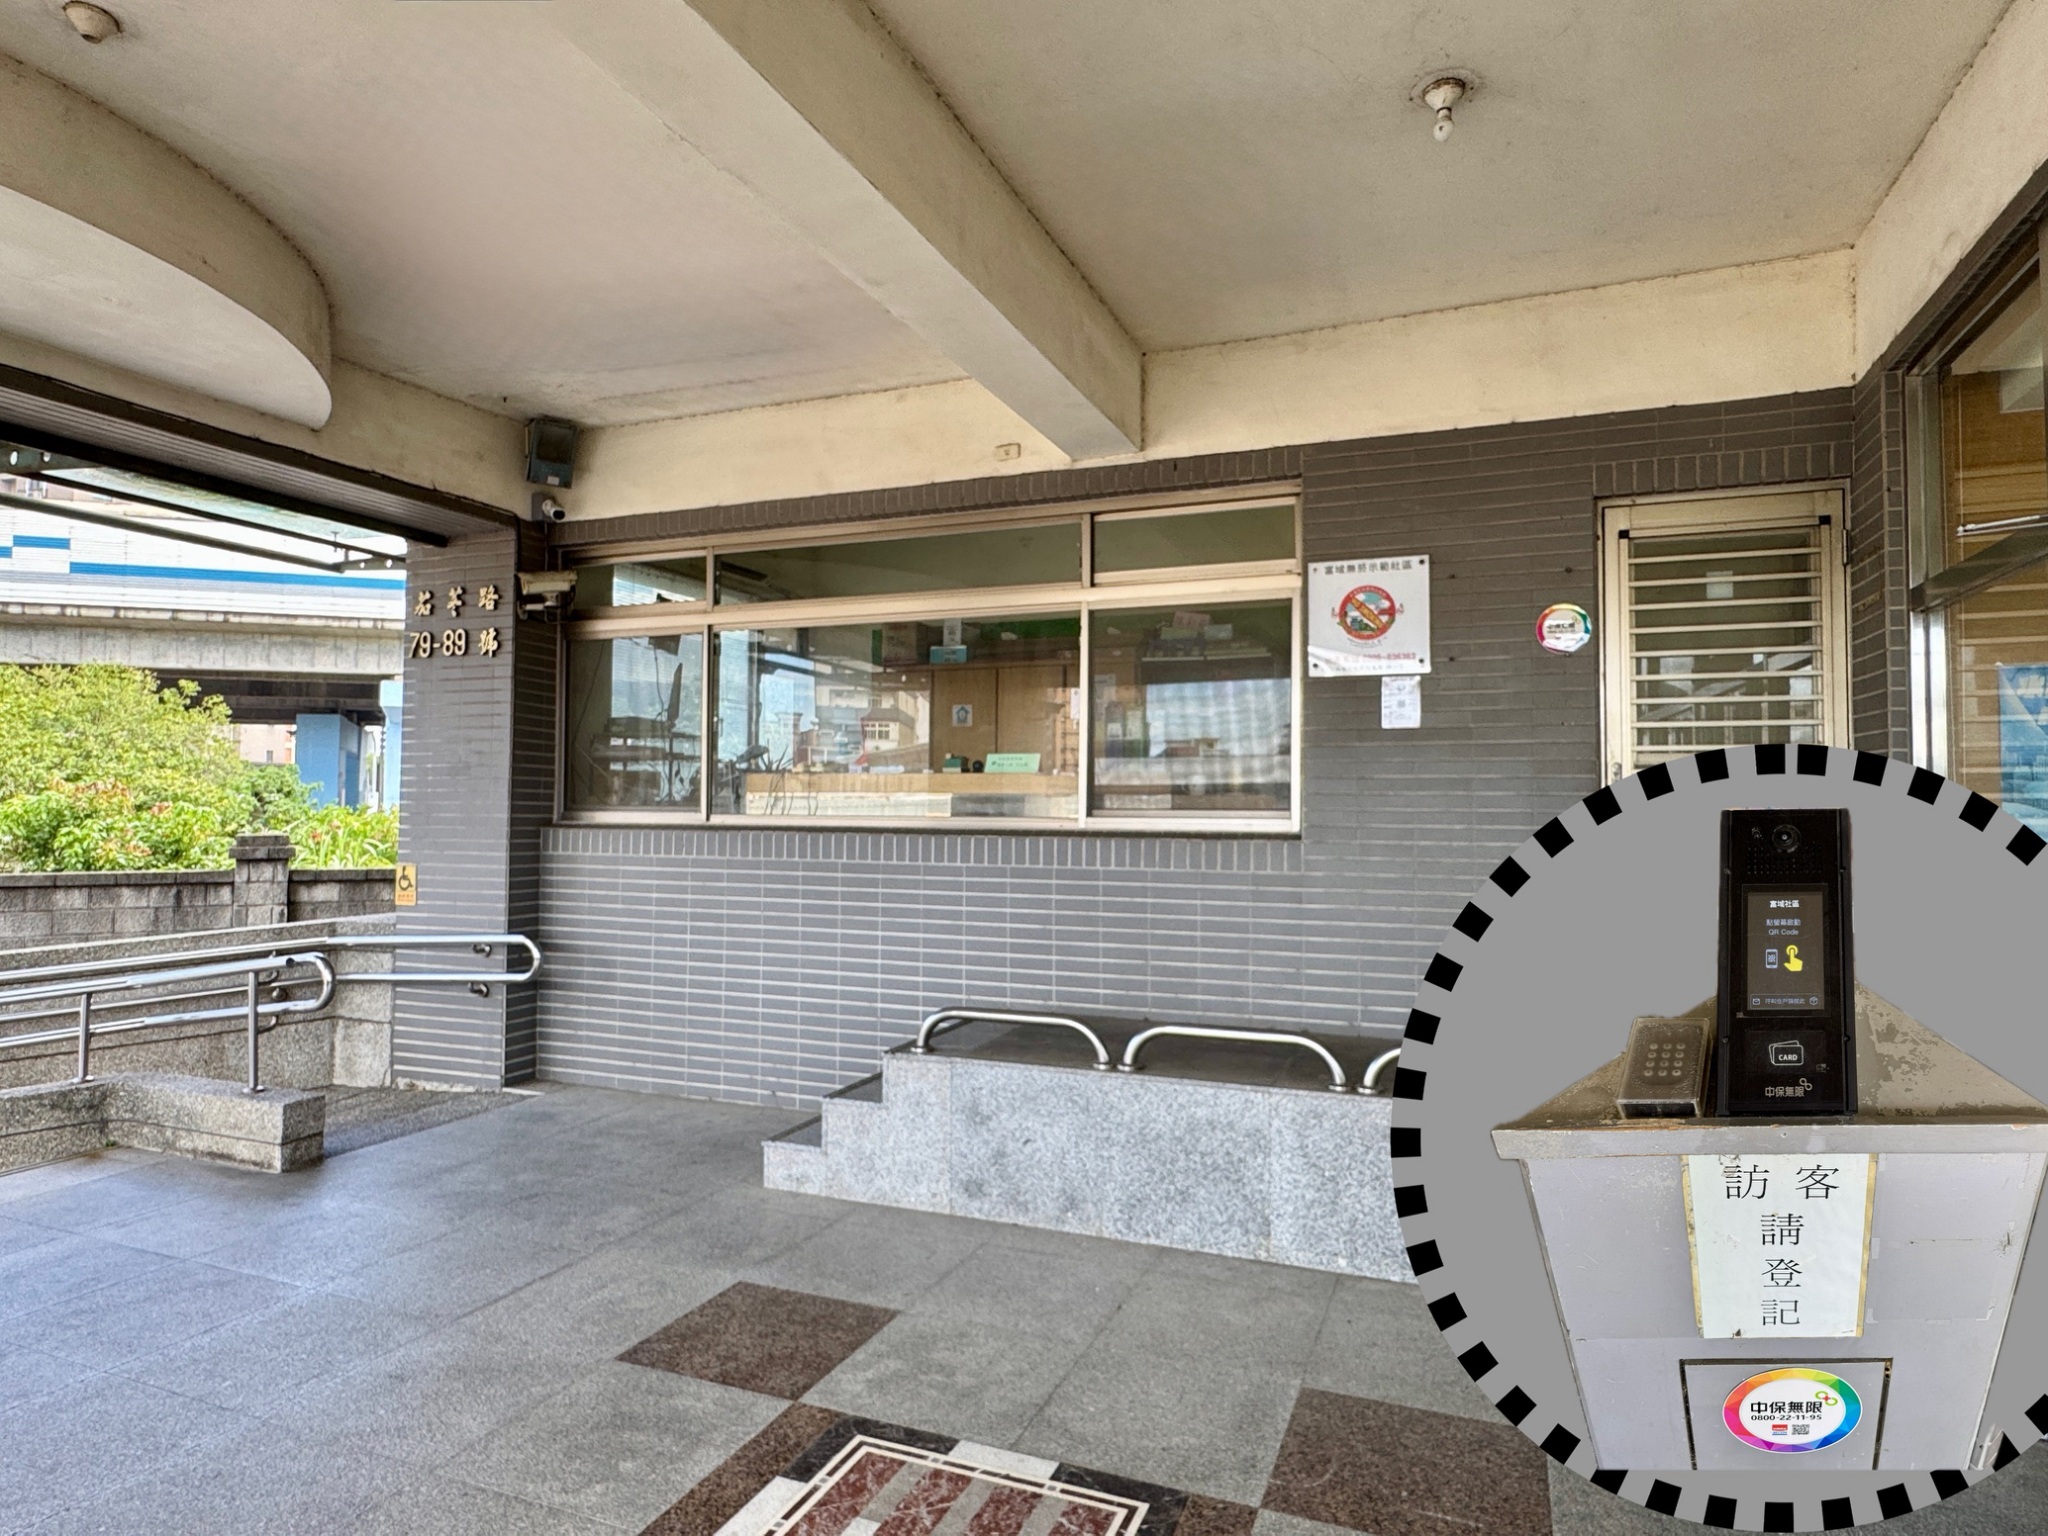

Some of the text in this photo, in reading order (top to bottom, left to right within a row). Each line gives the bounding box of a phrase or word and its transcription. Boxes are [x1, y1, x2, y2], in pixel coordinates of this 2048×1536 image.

[1768, 928, 1799, 936] QR Code
[1765, 1086, 1805, 1097] 中保無限
[1723, 1164, 1840, 1200] 訪客
[1750, 1401, 1823, 1414] 中保無限
